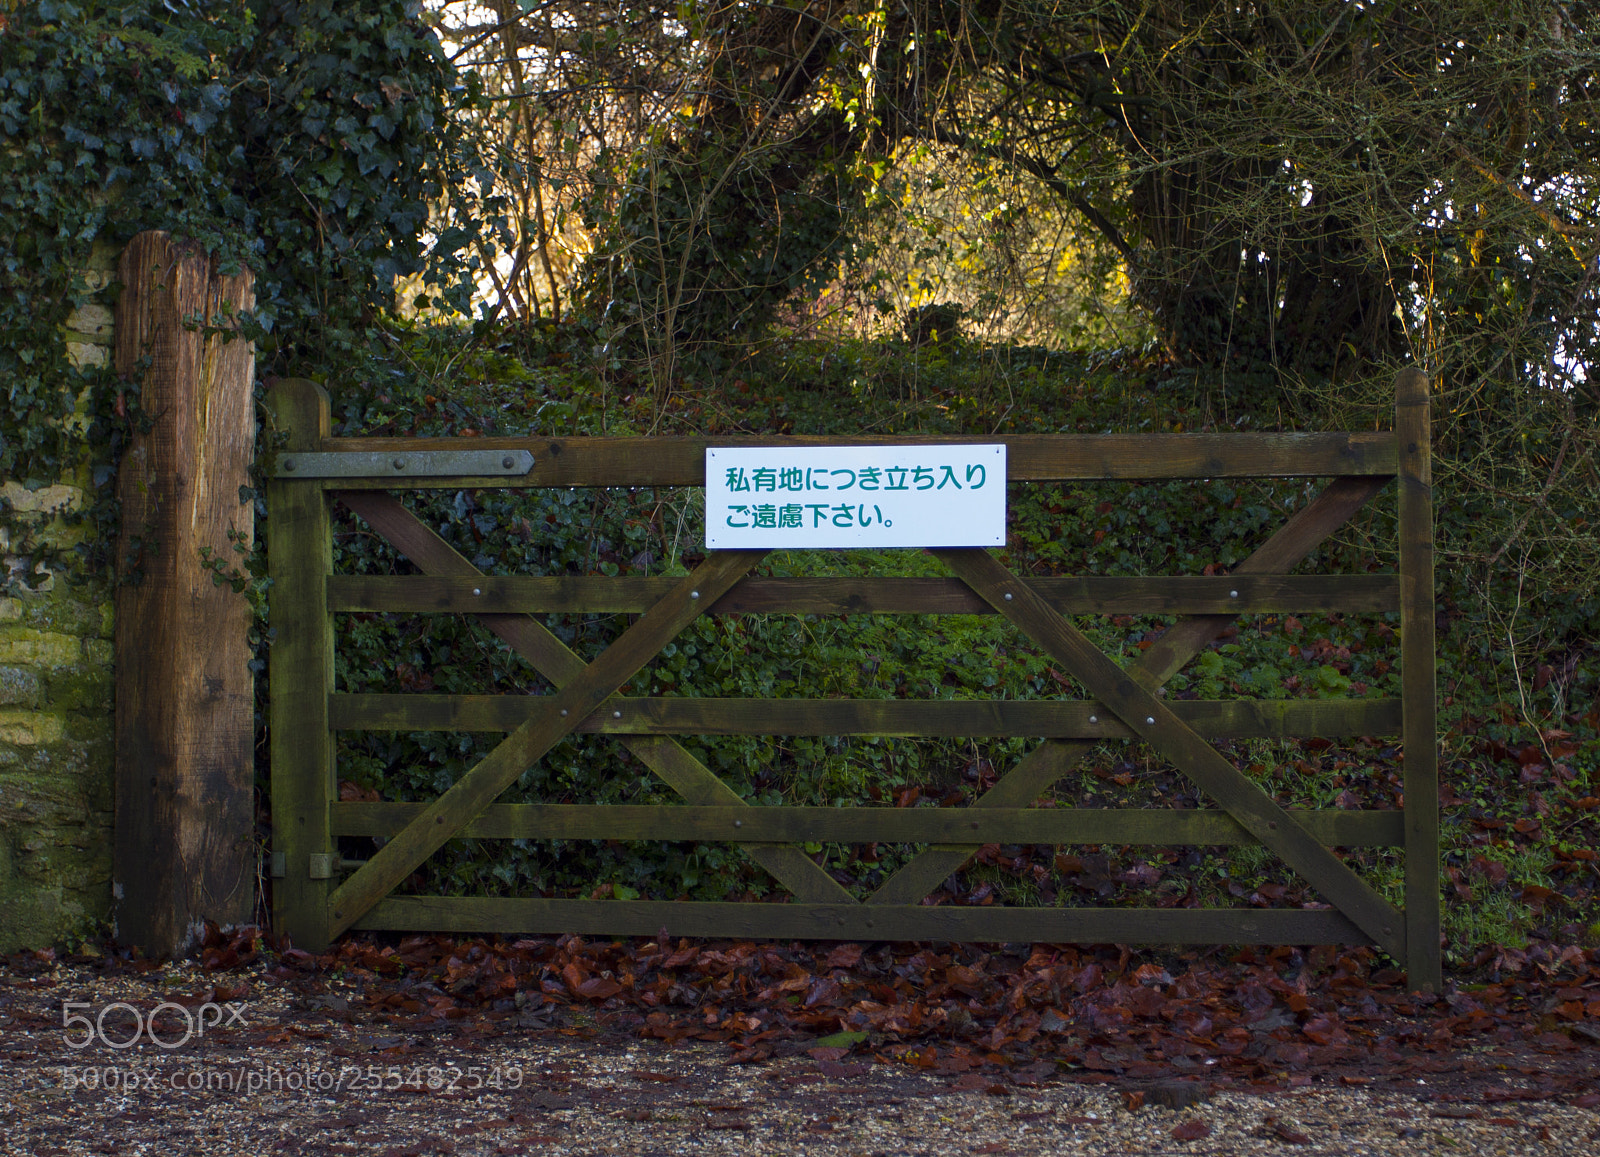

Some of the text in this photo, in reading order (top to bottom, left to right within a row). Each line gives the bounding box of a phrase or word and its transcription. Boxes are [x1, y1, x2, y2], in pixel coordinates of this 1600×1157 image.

[725, 464, 986, 492] 私有地につき立ち入り
[725, 503, 893, 528] ご遠慮下さい。
